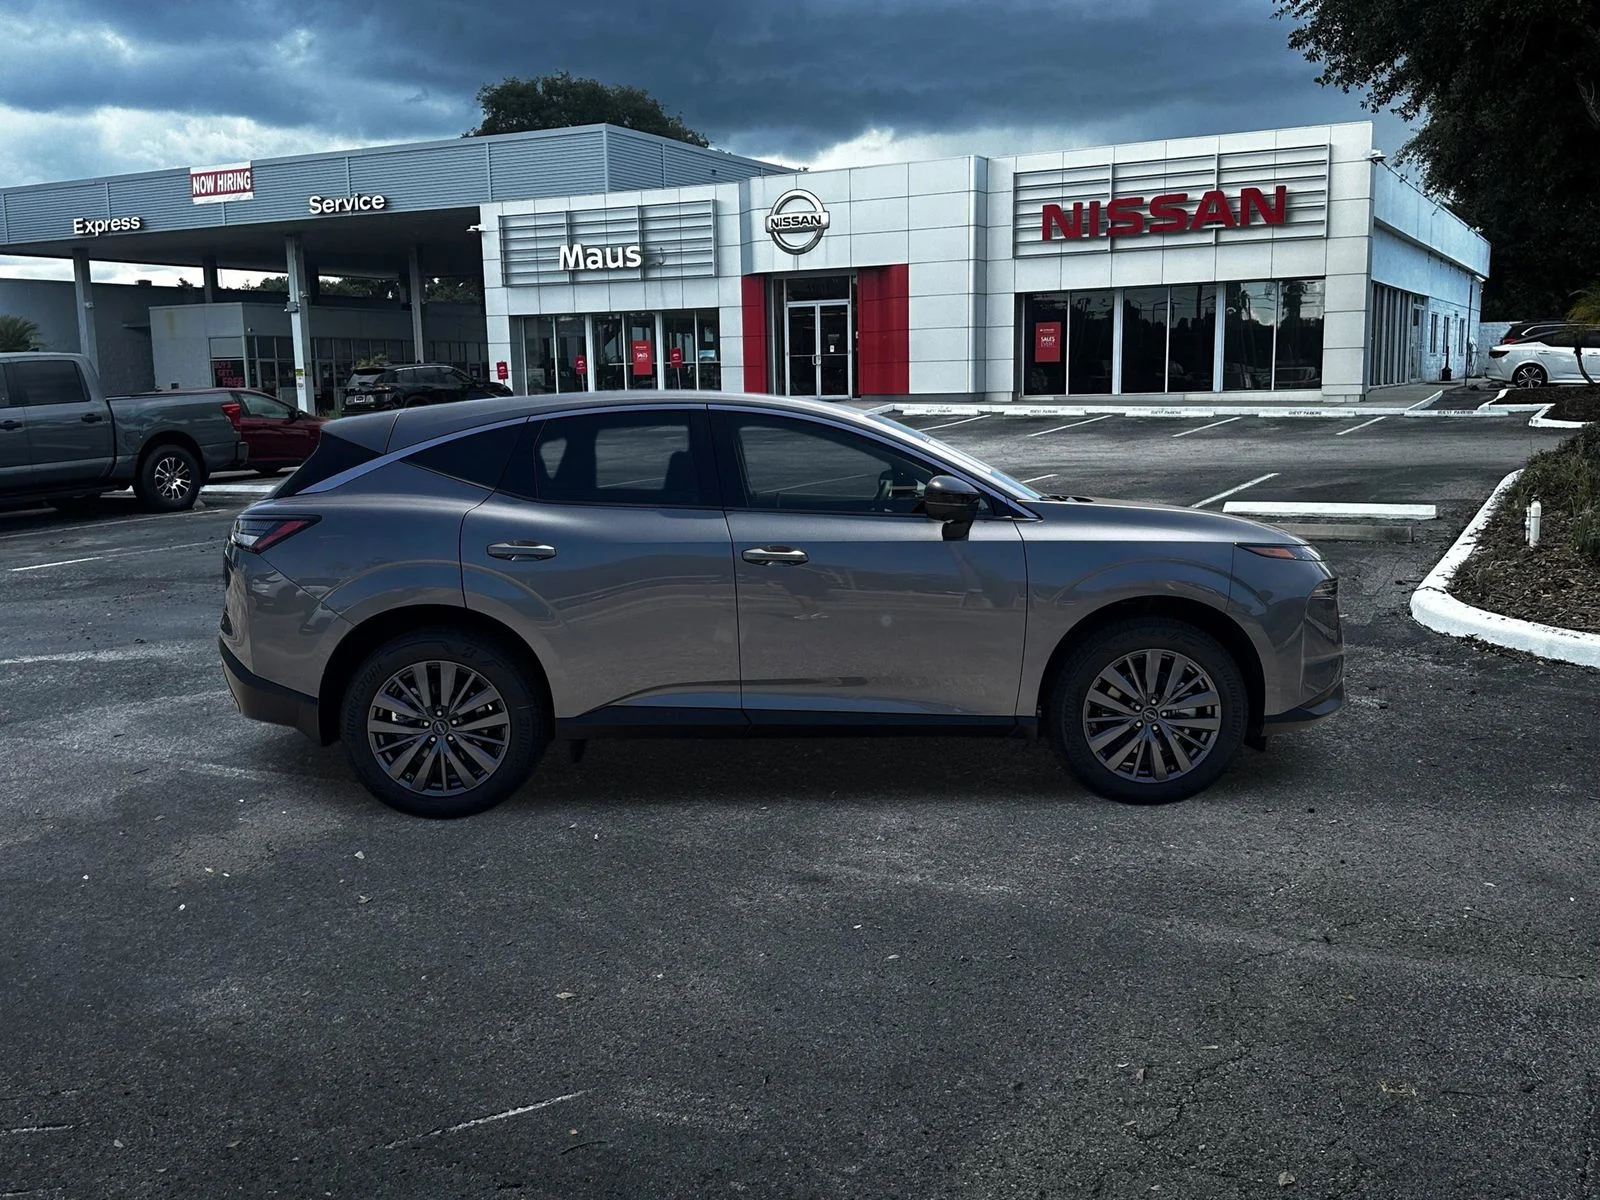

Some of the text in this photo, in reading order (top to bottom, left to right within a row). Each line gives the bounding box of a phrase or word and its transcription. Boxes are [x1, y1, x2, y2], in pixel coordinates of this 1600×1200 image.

[192, 171, 251, 195] NOW HIRING
[309, 193, 385, 214] Service
[1042, 185, 1287, 241] NISSAN
[73, 216, 141, 236] Express
[770, 215, 821, 228] NISSAN
[559, 243, 642, 270] Maus
[222, 377, 243, 386] FREE
